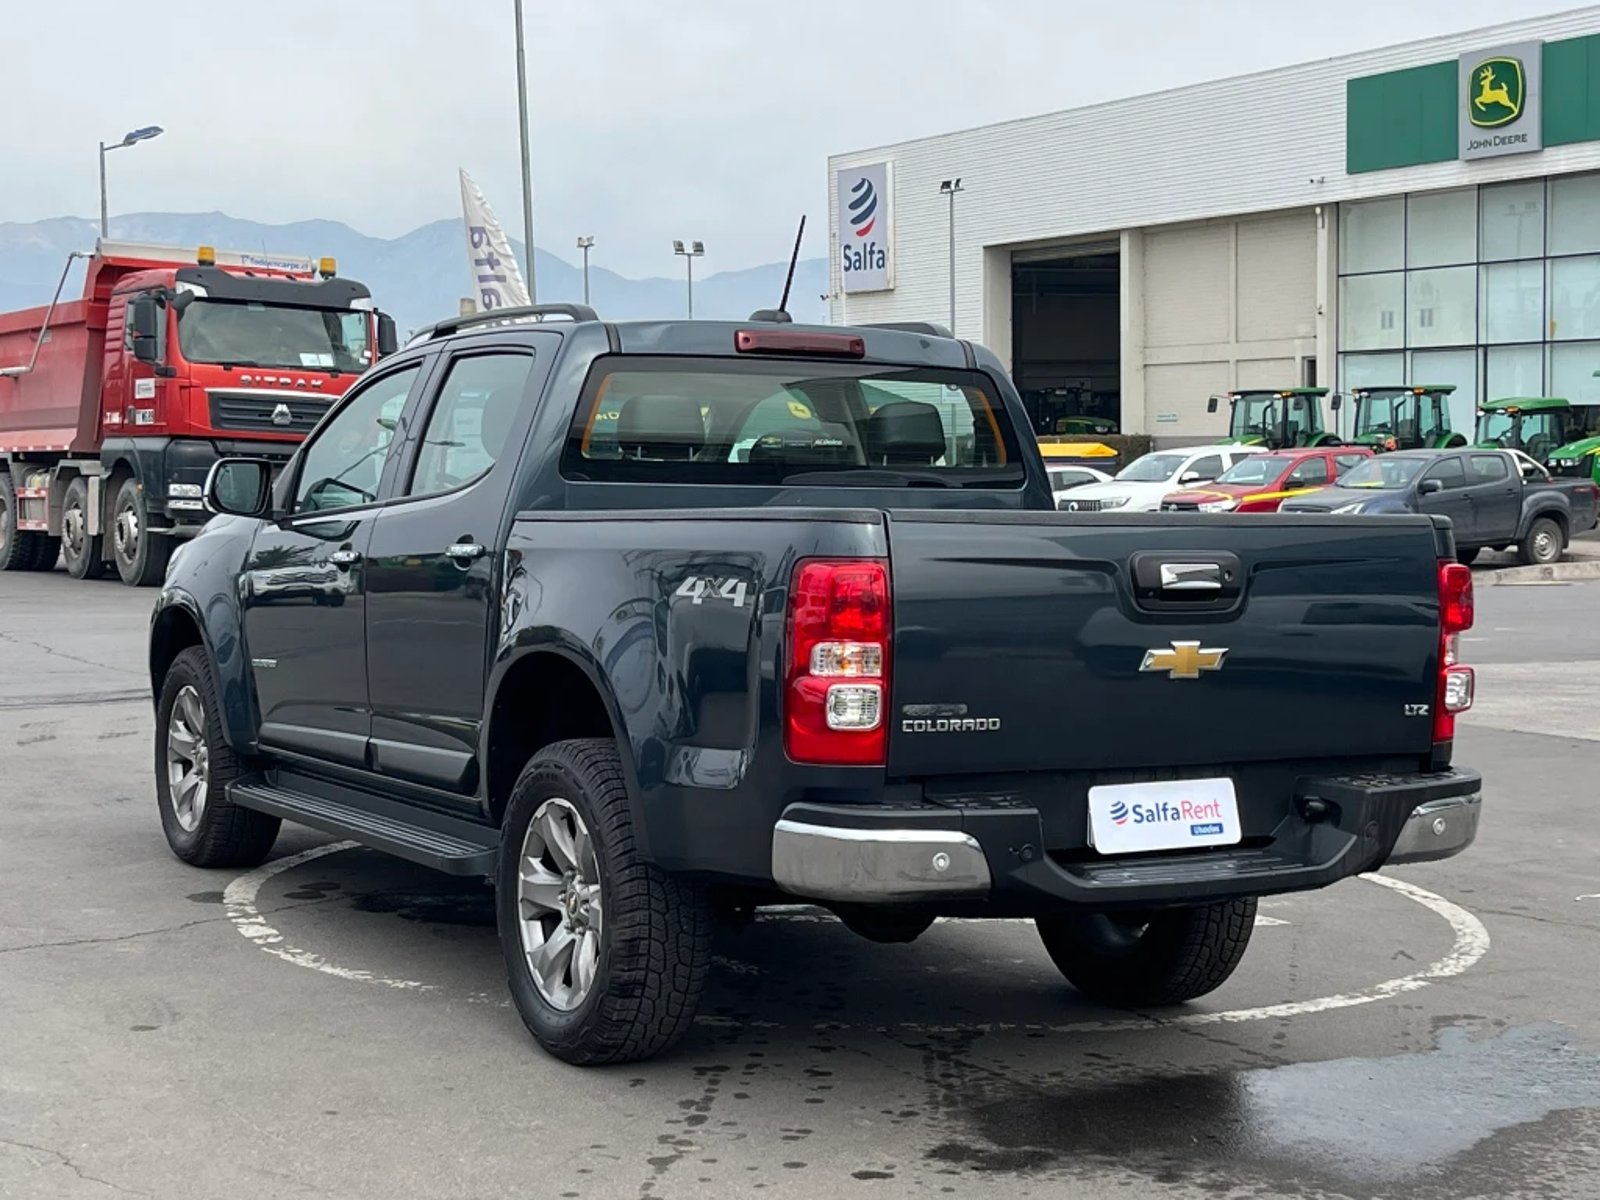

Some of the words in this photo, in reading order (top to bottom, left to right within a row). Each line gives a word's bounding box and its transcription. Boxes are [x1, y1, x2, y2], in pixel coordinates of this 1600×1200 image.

[1467, 139, 1492, 151] JOHN
[1493, 133, 1528, 147] DEERE
[843, 241, 885, 272] Salfa
[1404, 704, 1429, 716] LTZ
[902, 718, 1000, 732] COLORADO
